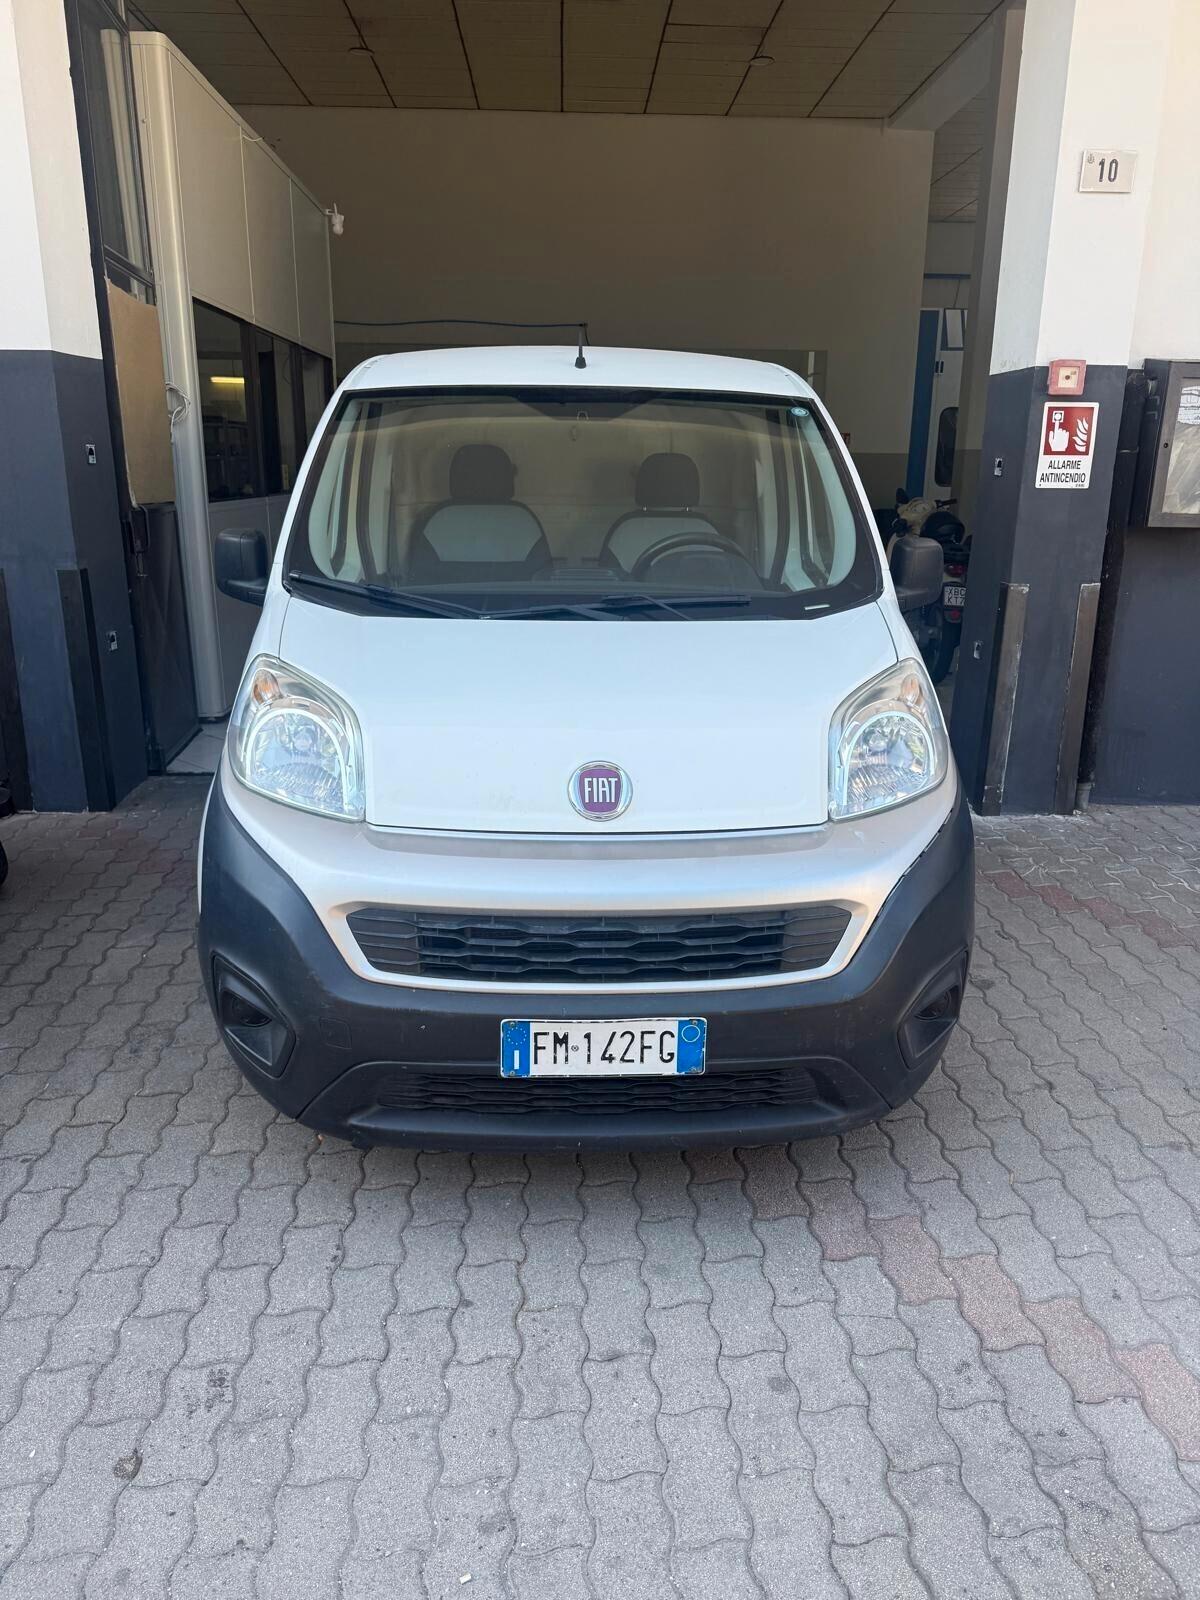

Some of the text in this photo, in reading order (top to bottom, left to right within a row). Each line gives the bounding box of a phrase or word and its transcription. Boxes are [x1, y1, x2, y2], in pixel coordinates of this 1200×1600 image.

[1098, 158, 1119, 183] 10
[1047, 459, 1082, 470] ALLARME
[1039, 472, 1086, 483] ANTINCENDIO
[584, 777, 618, 803] FIAT
[533, 1031, 569, 1065] FM
[584, 1030, 675, 1065] 142FG
